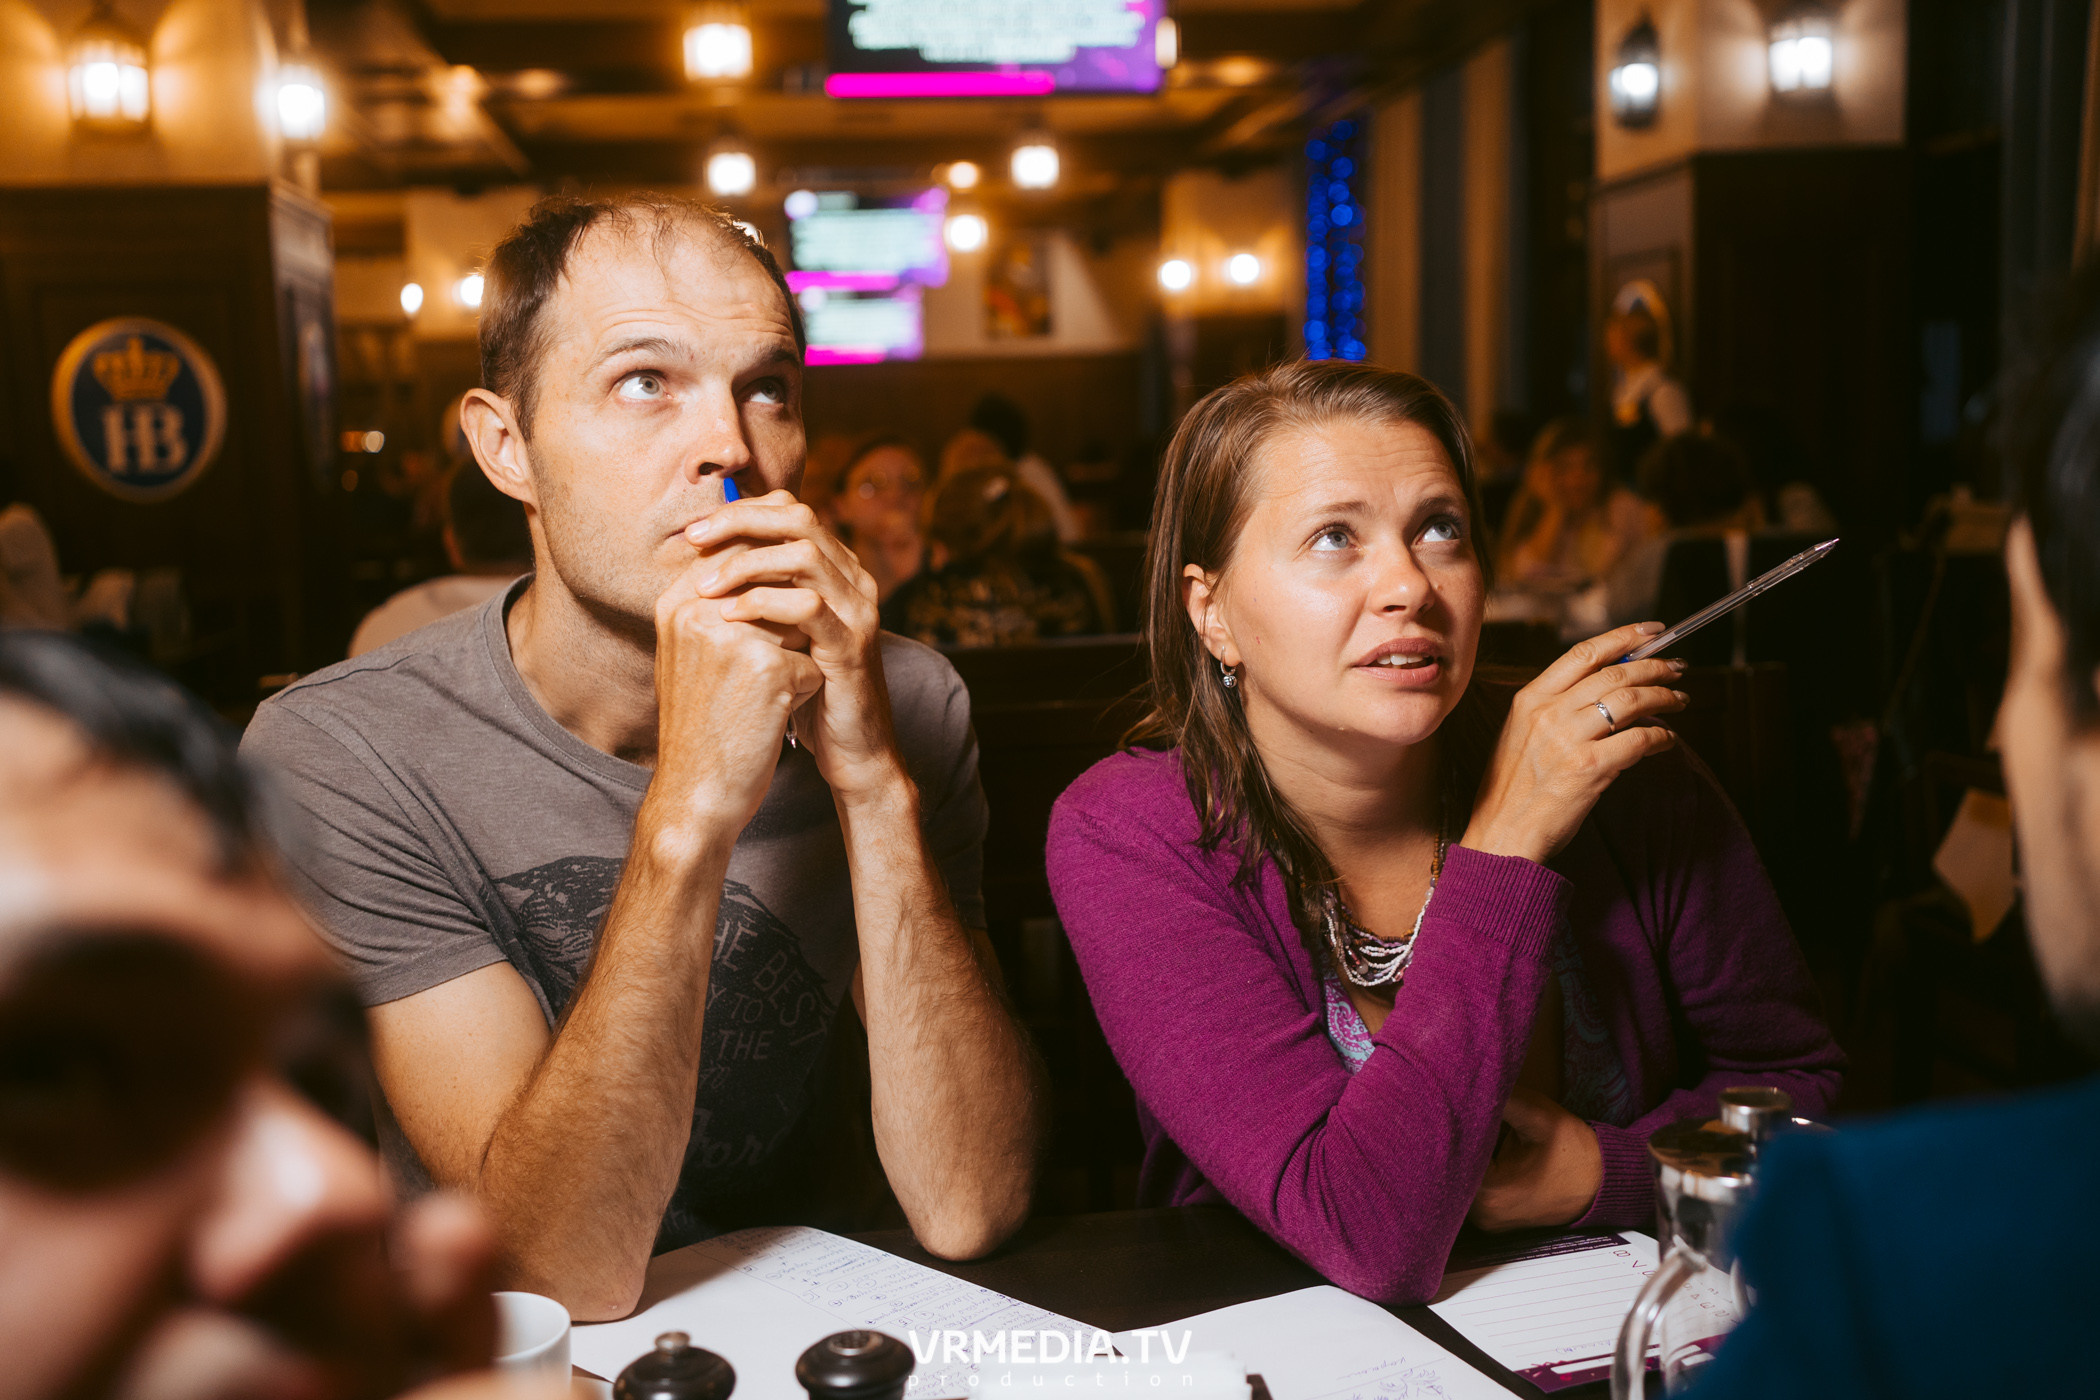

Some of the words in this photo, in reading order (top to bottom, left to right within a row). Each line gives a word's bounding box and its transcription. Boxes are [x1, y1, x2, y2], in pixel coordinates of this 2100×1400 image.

[103, 402, 188, 474] HB
[713, 919, 758, 972] HE
[753, 950, 828, 1047] BEST
[730, 991, 764, 1024] TO
[716, 1028, 774, 1061] THE
